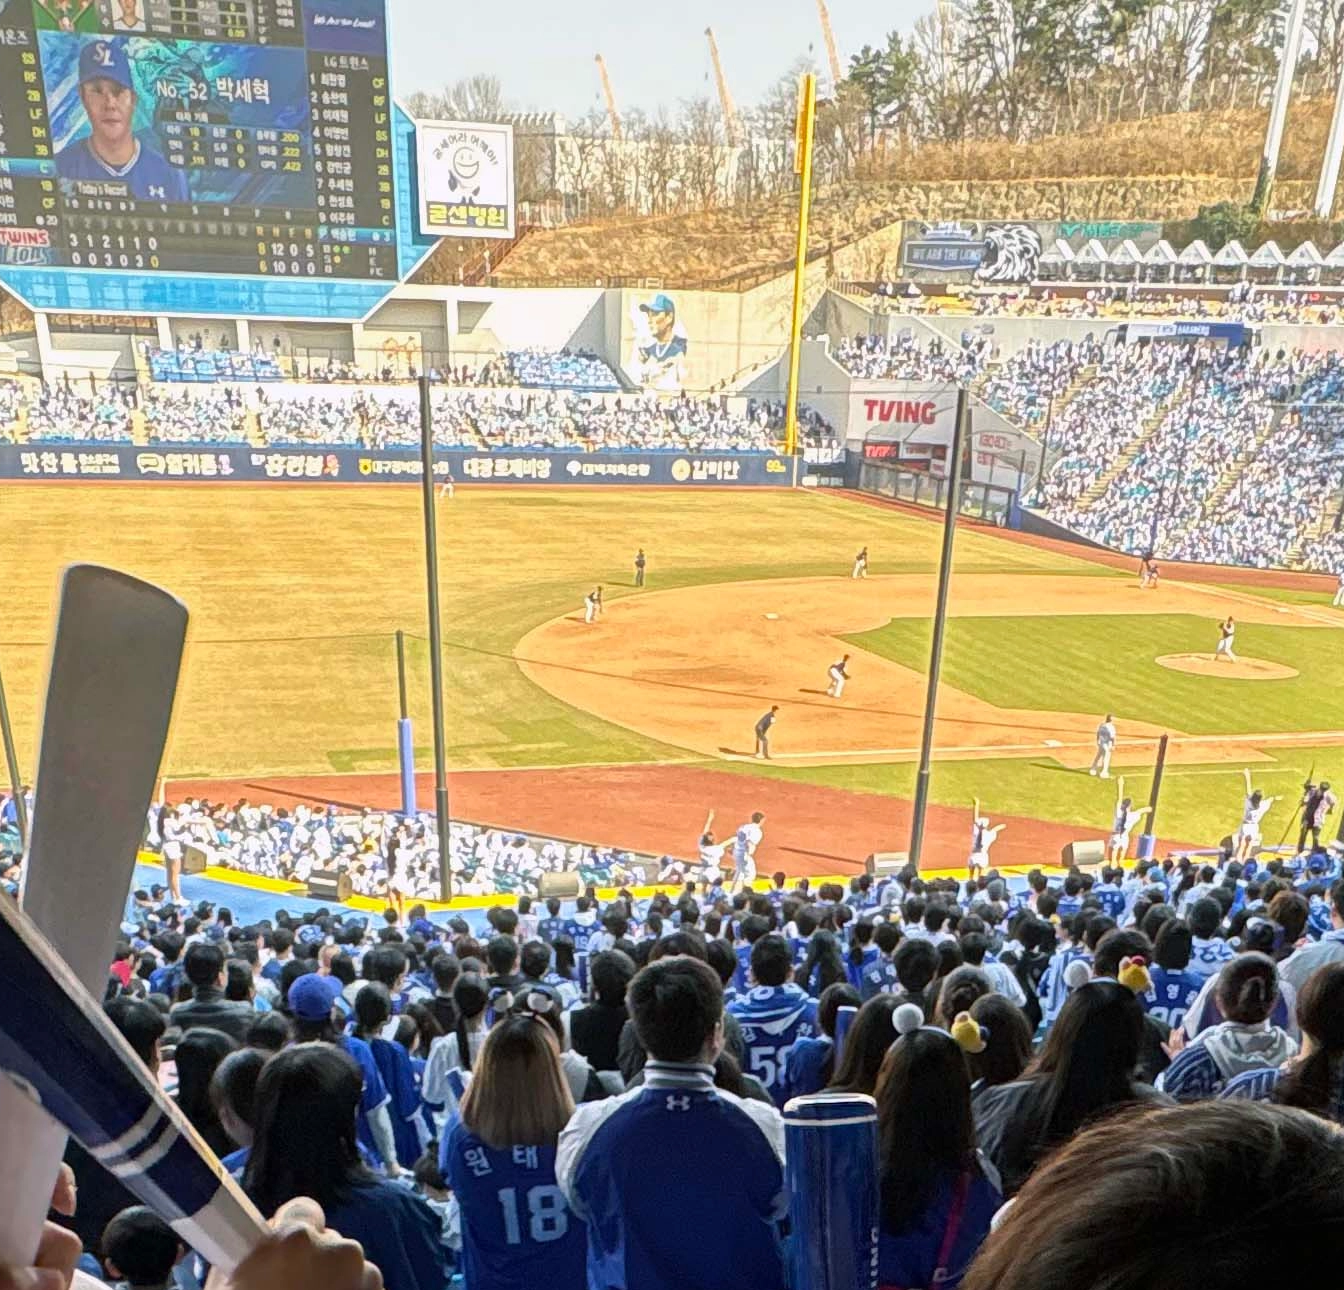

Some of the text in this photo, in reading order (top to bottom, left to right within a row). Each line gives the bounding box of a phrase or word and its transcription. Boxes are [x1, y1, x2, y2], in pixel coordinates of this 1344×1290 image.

[157, 76, 270, 105] No. 52 박세혁
[70, 233, 79, 246] 3
[86, 234, 93, 247] 1
[102, 234, 111, 248] 2
[118, 236, 124, 249] 1
[134, 236, 141, 249] 1
[148, 237, 157, 250] 0
[271, 243, 284, 256] 12
[290, 244, 298, 257] 0
[306, 244, 314, 258] 5
[72, 252, 81, 264] 0
[89, 253, 97, 265] 0
[105, 253, 113, 266] 3
[120, 254, 128, 266] 0
[136, 255, 144, 267] 3
[150, 255, 159, 268] 0
[273, 261, 286, 273] 10
[291, 261, 299, 274] 0
[307, 262, 315, 275] 0
[864, 399, 937, 425] TVING
[462, 1142, 540, 1178] 원태
[497, 1184, 569, 1245] 18
